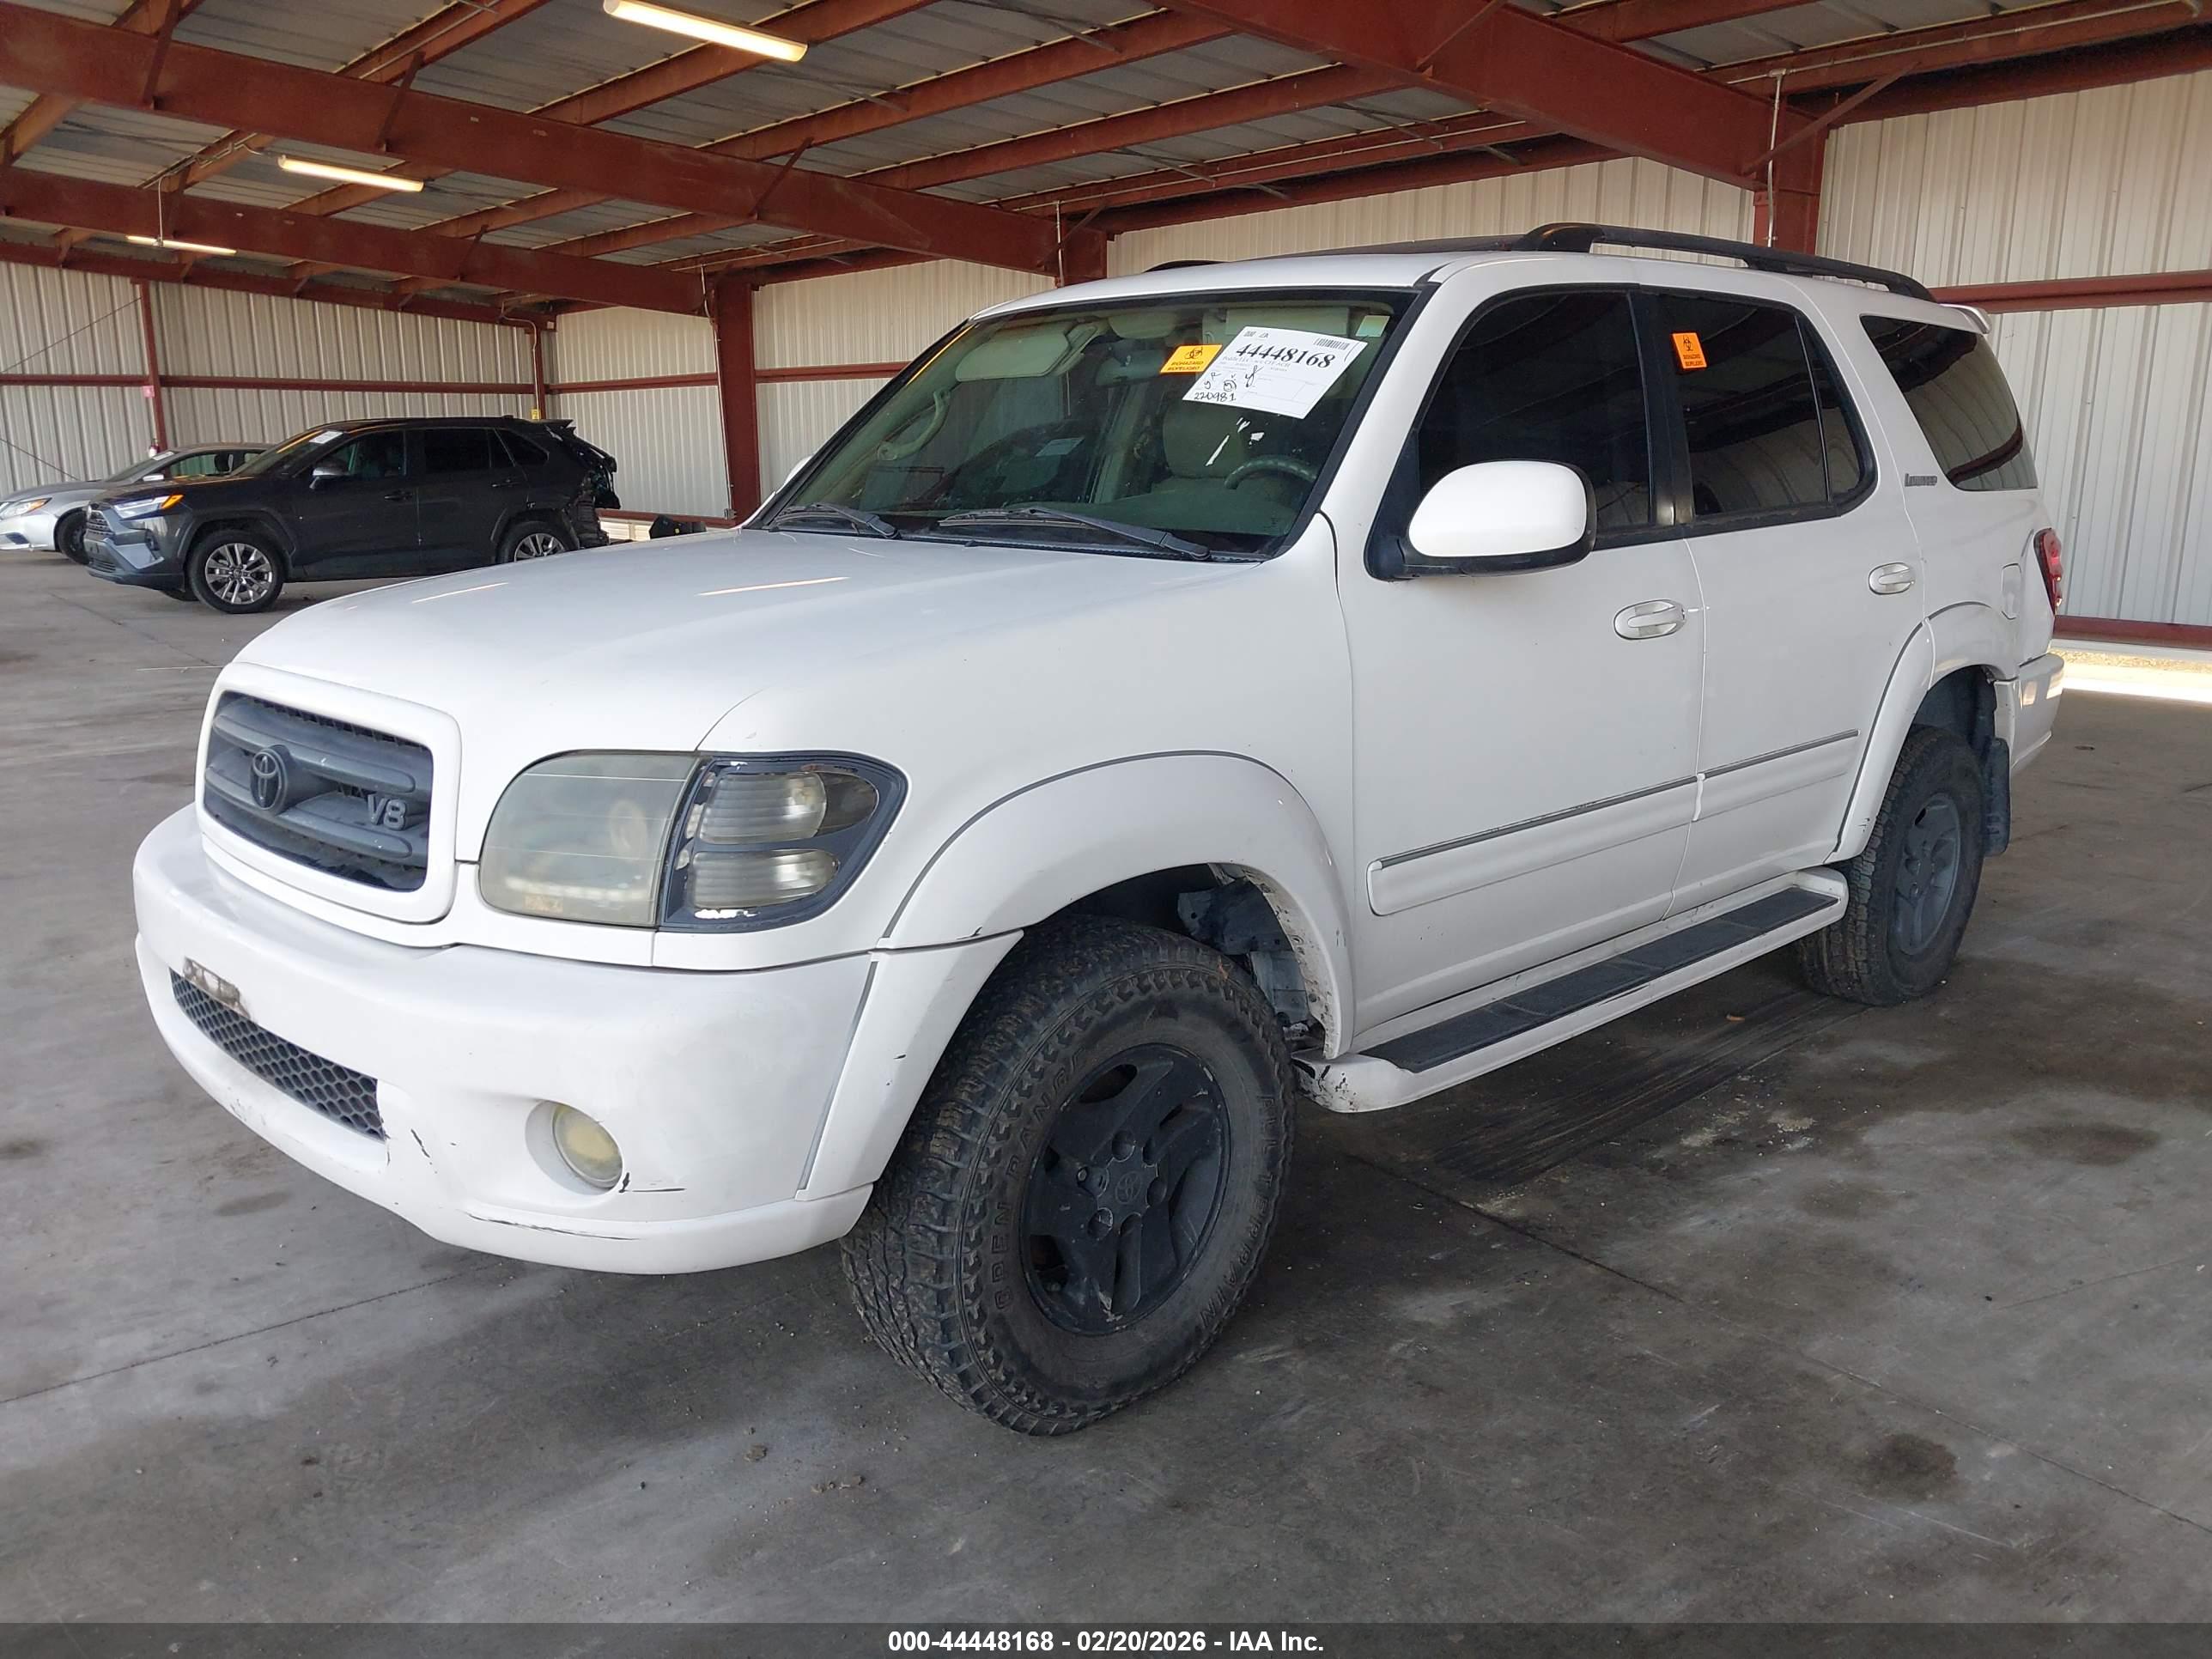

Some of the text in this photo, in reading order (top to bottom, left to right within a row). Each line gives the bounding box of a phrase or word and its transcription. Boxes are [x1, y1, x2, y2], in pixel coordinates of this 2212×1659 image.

[1236, 343, 1335, 368] 44448168
[367, 793, 407, 831] V8
[990, 1201, 1014, 1310] OPEN
